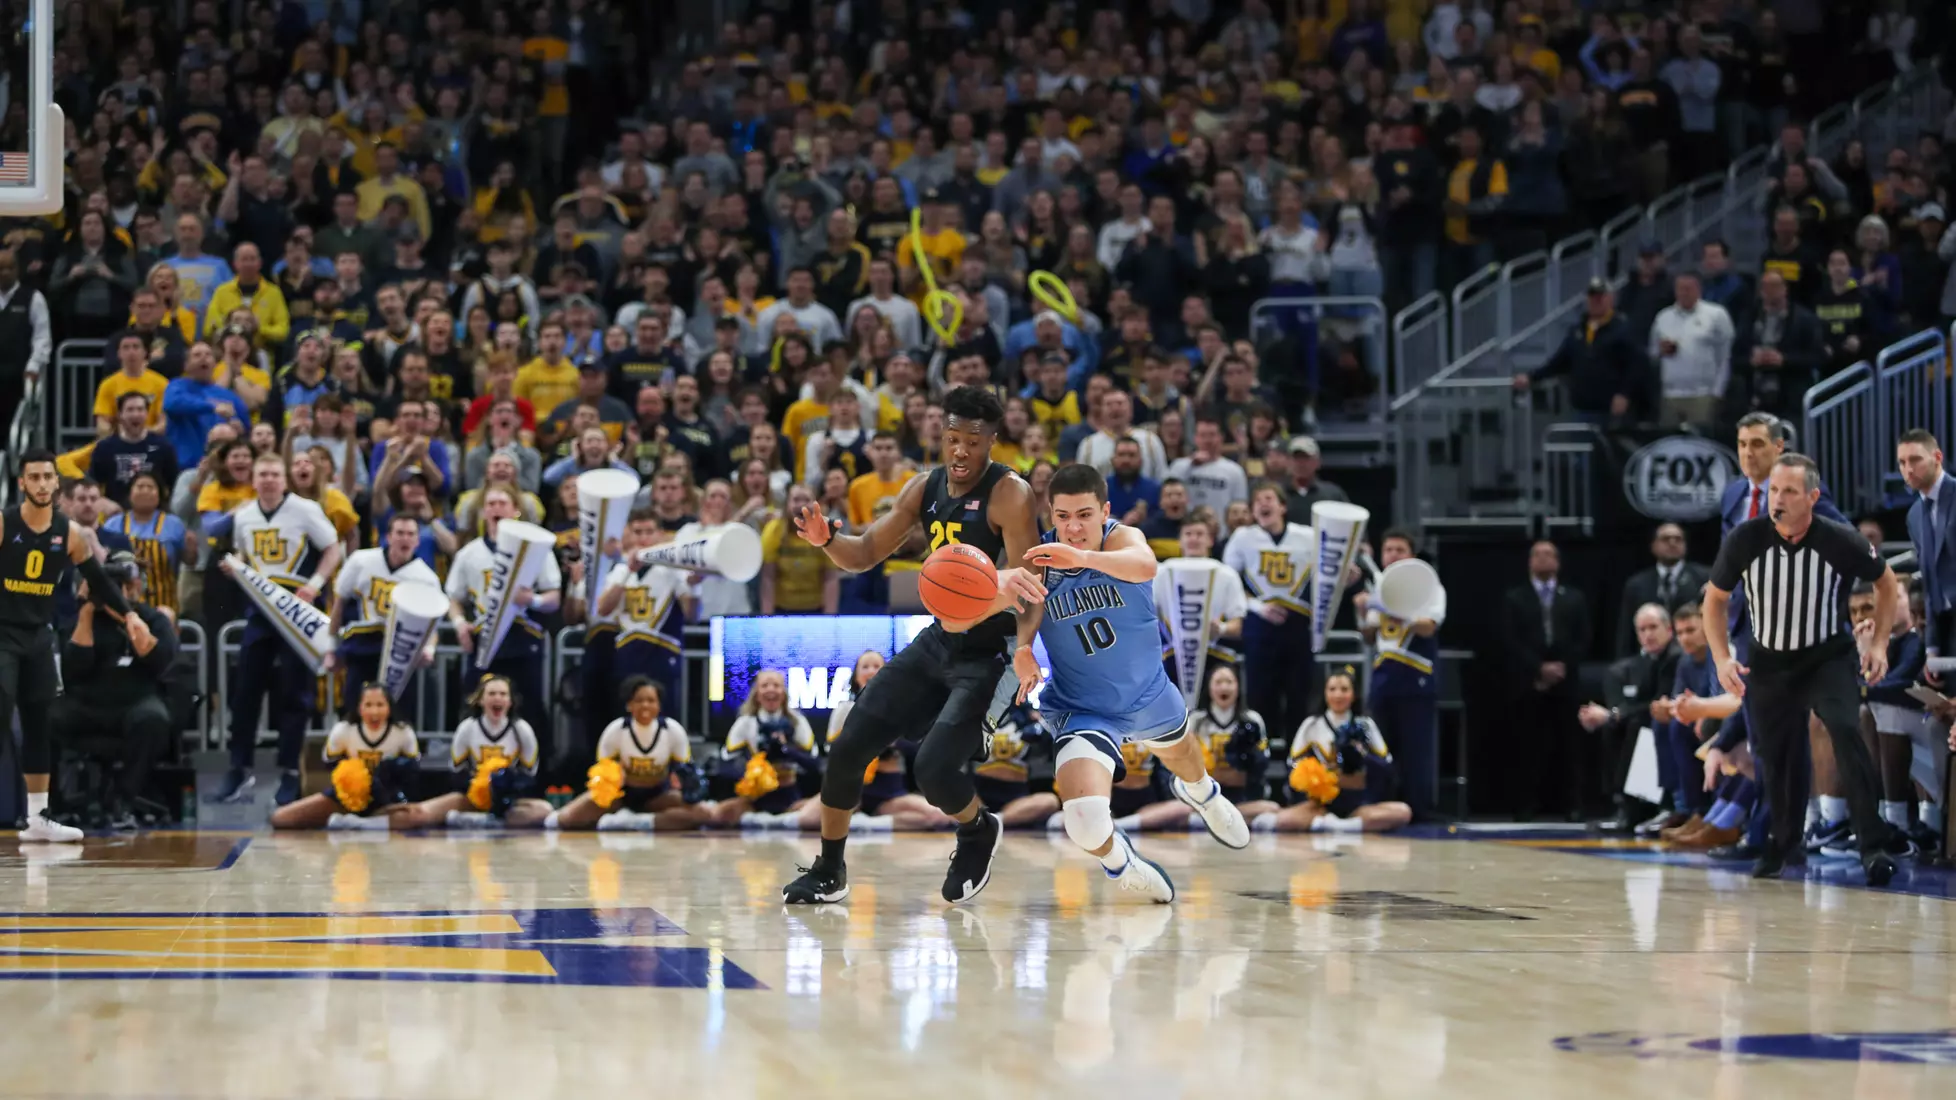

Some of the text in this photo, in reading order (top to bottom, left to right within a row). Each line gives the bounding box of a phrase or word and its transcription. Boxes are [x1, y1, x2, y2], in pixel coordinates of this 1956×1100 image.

[1650, 454, 1716, 487] FOX
[253, 528, 288, 564] MU
[929, 520, 962, 552] 25
[24, 548, 45, 580] 0
[1258, 550, 1297, 588] MU
[1044, 583, 1127, 623] VILLANOVA
[1178, 584, 1204, 631] OUT
[1073, 616, 1117, 656] 10
